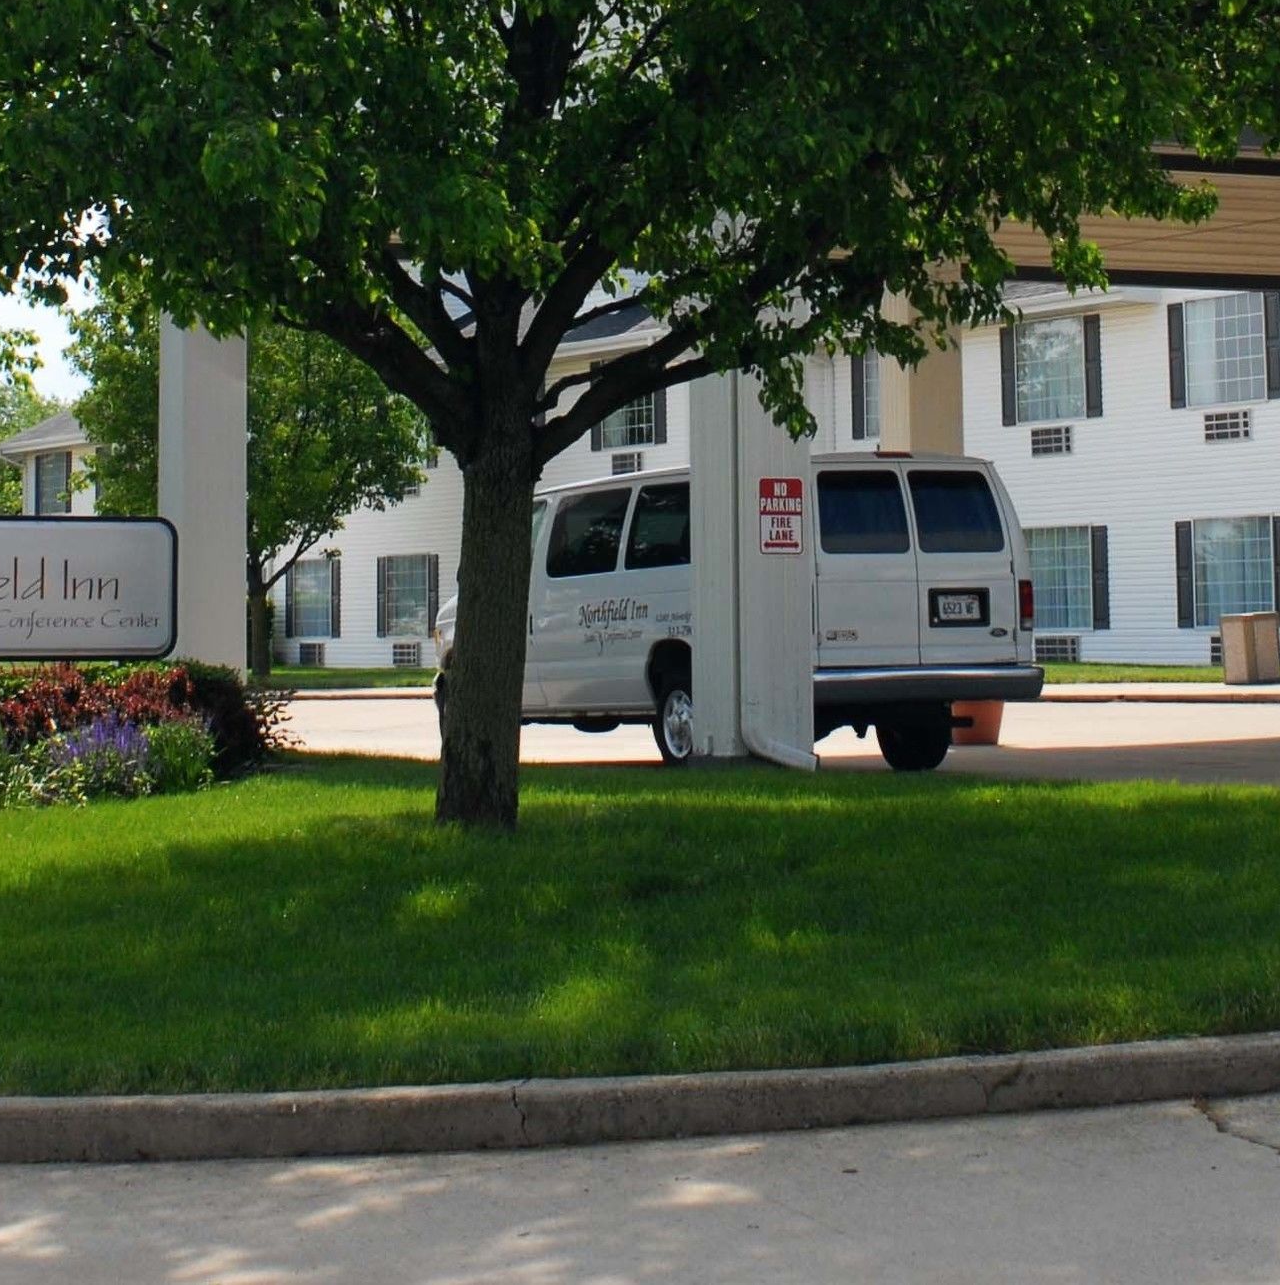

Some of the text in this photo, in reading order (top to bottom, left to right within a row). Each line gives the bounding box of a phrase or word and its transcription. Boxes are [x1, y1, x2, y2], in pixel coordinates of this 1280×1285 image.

[774, 482, 788, 496] NO
[760, 498, 802, 512] PARKING
[771, 517, 792, 528] FIRE
[769, 530, 794, 541] LANE
[62, 559, 119, 600] Inn
[101, 609, 160, 629] Center
[579, 598, 630, 629] Northfield
[631, 600, 649, 620] Inn
